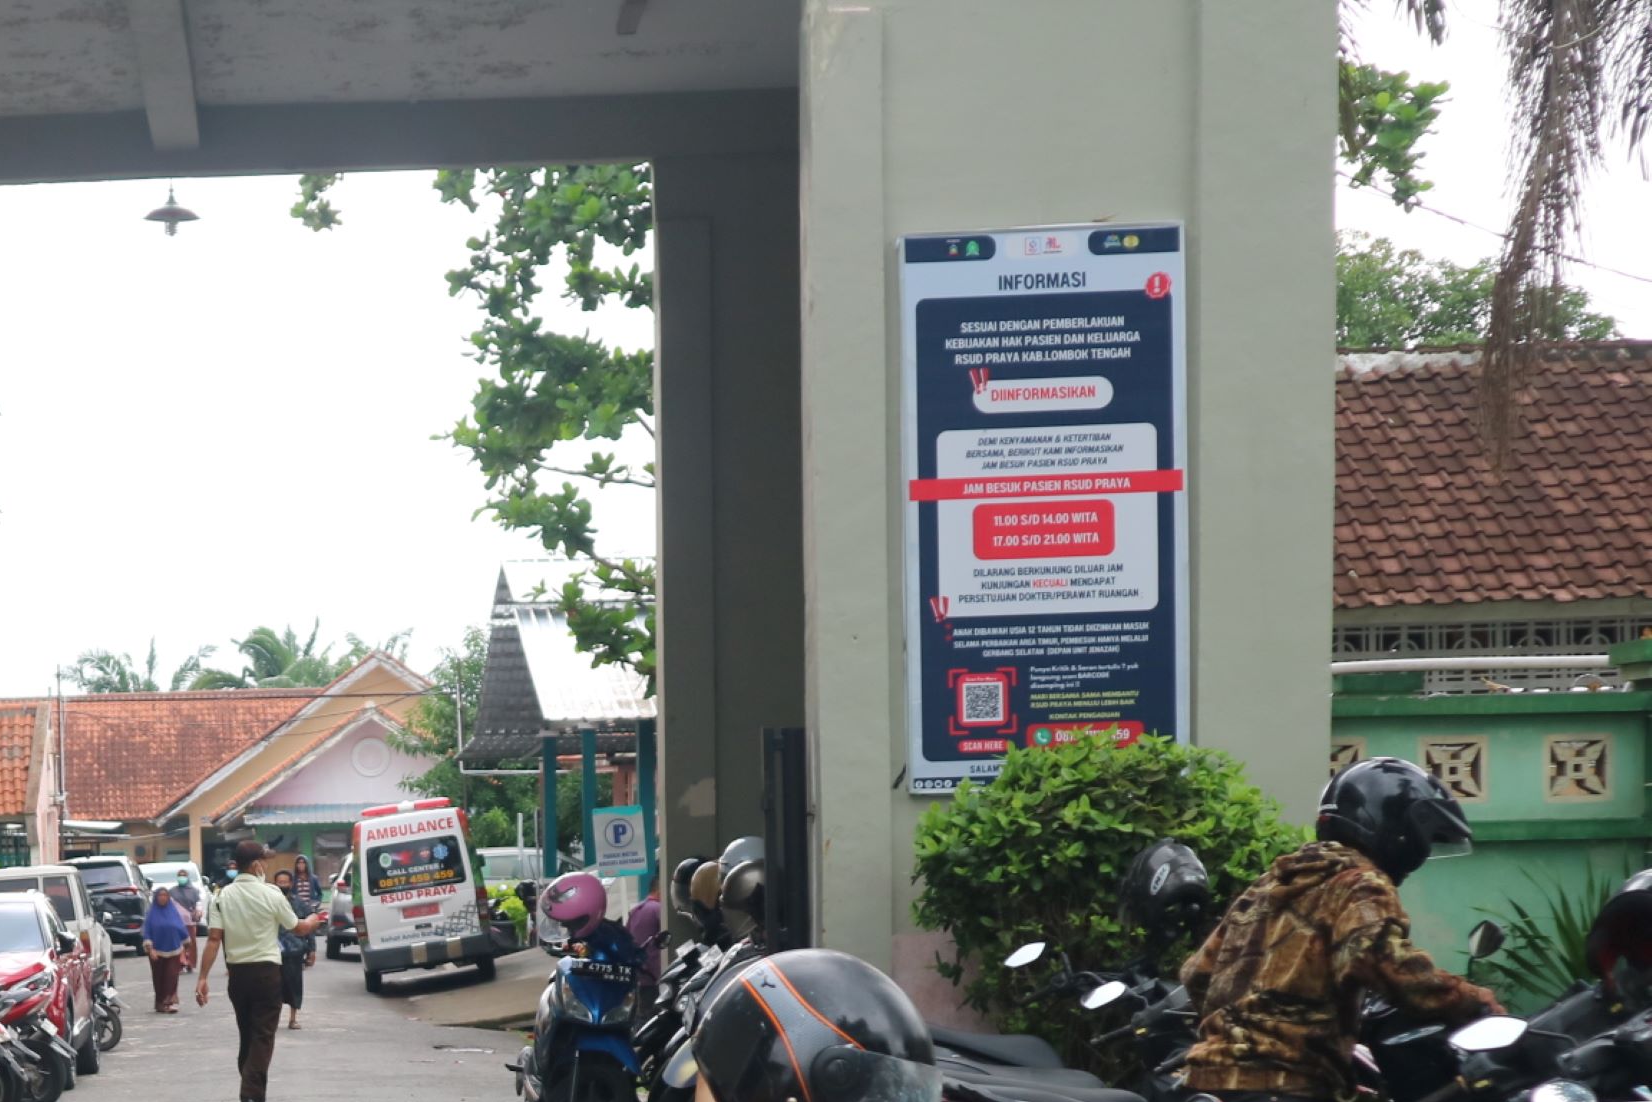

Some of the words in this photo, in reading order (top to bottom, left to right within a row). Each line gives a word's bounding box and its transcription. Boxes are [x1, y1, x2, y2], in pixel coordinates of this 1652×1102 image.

[998, 272, 1086, 291] INFORMASI
[961, 321, 997, 333] SESUAI
[999, 320, 1040, 331] DENGAN
[1043, 317, 1124, 330] PEMBERLAKUAN
[946, 337, 999, 349] KEBIJAKAN
[1001, 336, 1022, 347] HAK
[1024, 335, 1061, 346] PASIEN
[1064, 334, 1085, 344] DAN
[1087, 332, 1140, 344] KELUARGA
[955, 353, 983, 364] RSUD
[985, 352, 1020, 363] PRAYA
[1091, 348, 1131, 359] TENGAH
[991, 386, 1096, 401] DIINFORMASIKAN
[978, 437, 998, 445] DEMI
[999, 435, 1053, 444] KENYAMANAN
[1063, 433, 1111, 442] KETERTIBAN
[1008, 448, 1041, 457] BERIKUT
[1043, 447, 1063, 455] KAMI
[982, 461, 998, 469] JAM
[1000, 460, 1026, 469] BESUK
[1027, 459, 1056, 467] PASIEN
[1058, 458, 1079, 466] RSUD
[1081, 457, 1108, 465] PRAYA
[963, 484, 985, 495] JAM
[987, 482, 1021, 494] BESUK
[1024, 481, 1061, 492] PASIEN
[1064, 480, 1093, 490] RSUD
[1095, 478, 1130, 489] PRAYA
[1021, 514, 1040, 525] S/D
[1043, 513, 1068, 524] 14.00
[1071, 512, 1098, 523] WITA
[993, 535, 1019, 546] 17.00
[1022, 534, 1041, 546] S/D
[1044, 534, 1071, 544] 21.00
[1073, 533, 1099, 543] WITA
[973, 568, 1015, 578] DILARANG
[1017, 566, 1072, 576] BERKUNJUNG
[1075, 565, 1105, 574] DILUAR
[1107, 564, 1123, 573] JAM
[981, 580, 1031, 590] KUNJUNGAN
[1033, 579, 1068, 588] KECUALI
[1070, 577, 1115, 587] MENDAPAT
[959, 593, 1017, 603] PERSETUJUAN
[1019, 590, 1096, 601] DOKTER/PERAWAT
[1099, 589, 1139, 598] RUANGAN
[367, 817, 454, 842] AMBULANCE
[613, 824, 627, 843] P
[381, 892, 413, 904] RSUD
[417, 885, 456, 897] PRAYA
